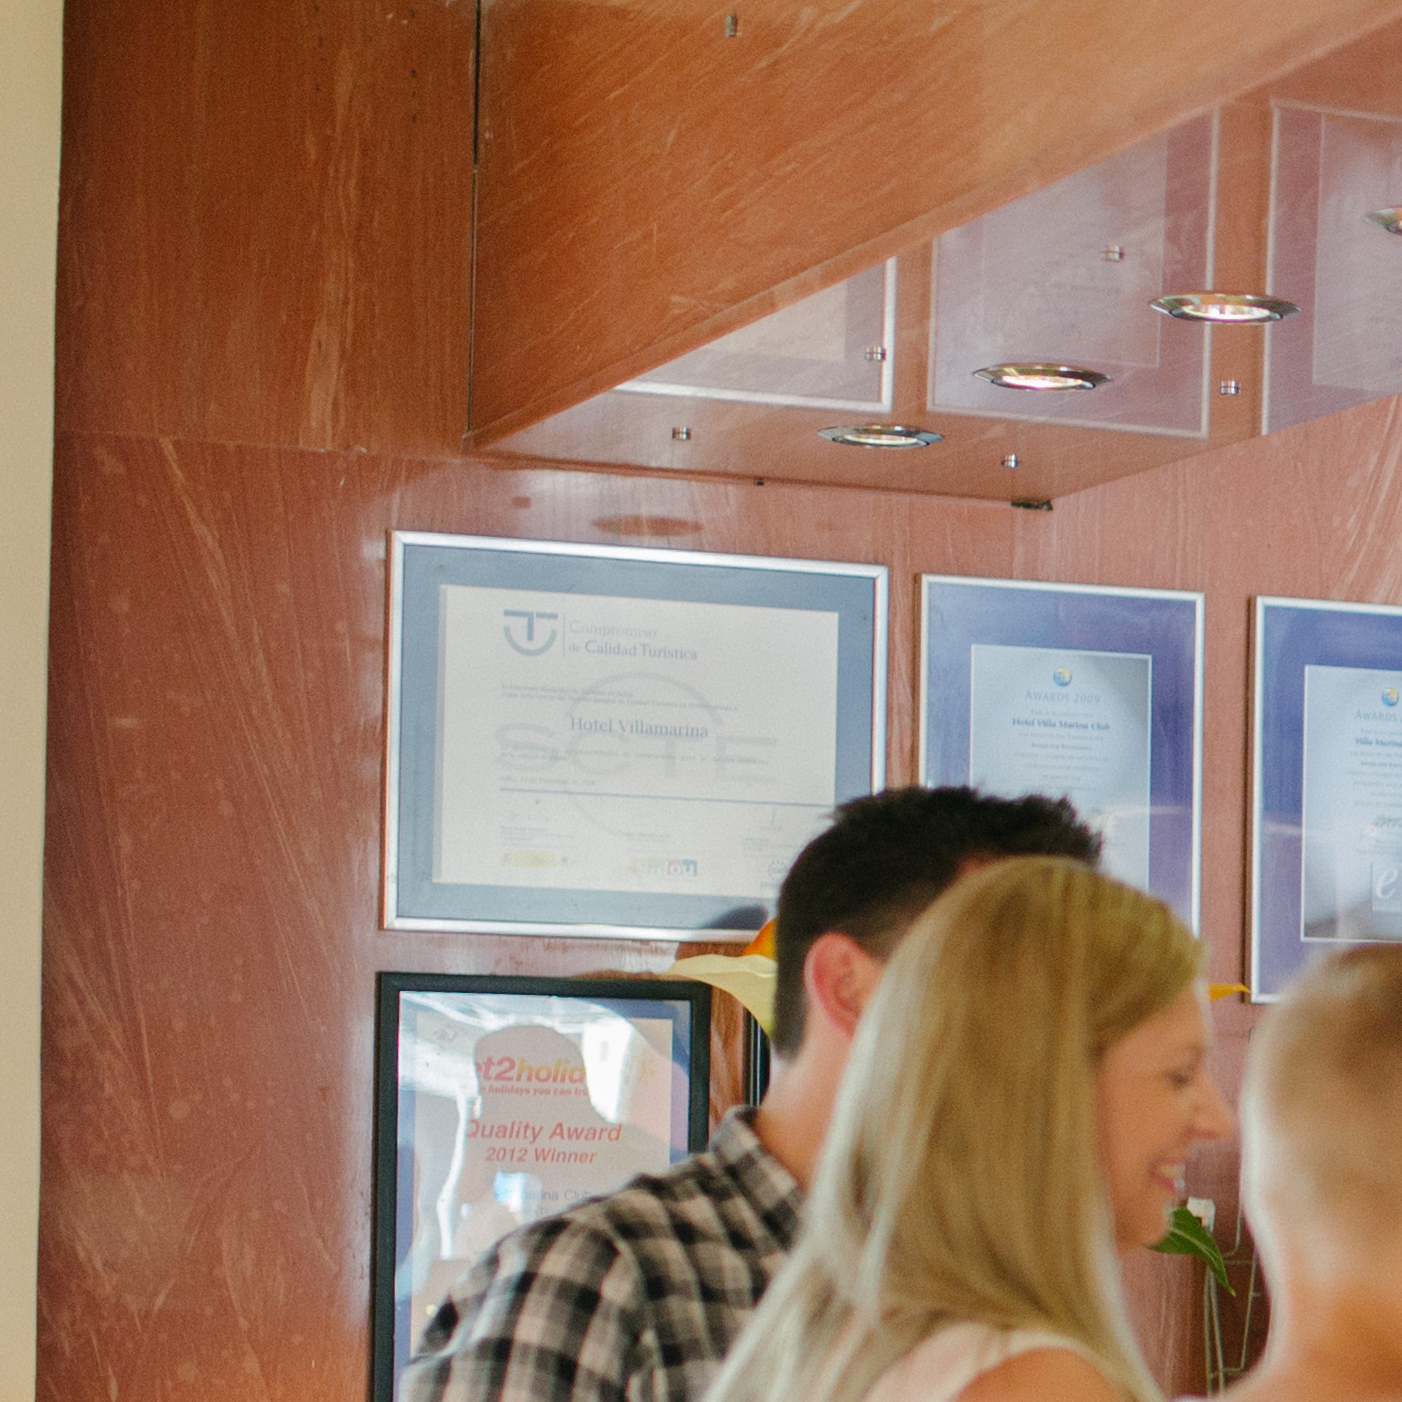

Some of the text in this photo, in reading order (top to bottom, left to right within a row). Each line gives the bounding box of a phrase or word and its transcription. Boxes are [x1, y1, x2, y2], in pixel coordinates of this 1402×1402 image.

[569, 619, 658, 639] Compromiso
[584, 639, 637, 656] Calidad
[570, 716, 709, 739] Hotel Villamarina
[1012, 717, 1111, 731] Hotel Villa Marina Club
[1355, 736, 1374, 746] Villa
[1375, 737, 1402, 748] Marina
[488, 1086, 531, 1097] holidays
[533, 1088, 552, 1097] you
[553, 1087, 572, 1096] can
[574, 1086, 589, 1096] tru
[467, 1119, 623, 1145] Quality Award
[485, 1146, 598, 1164] 2012 Winner
